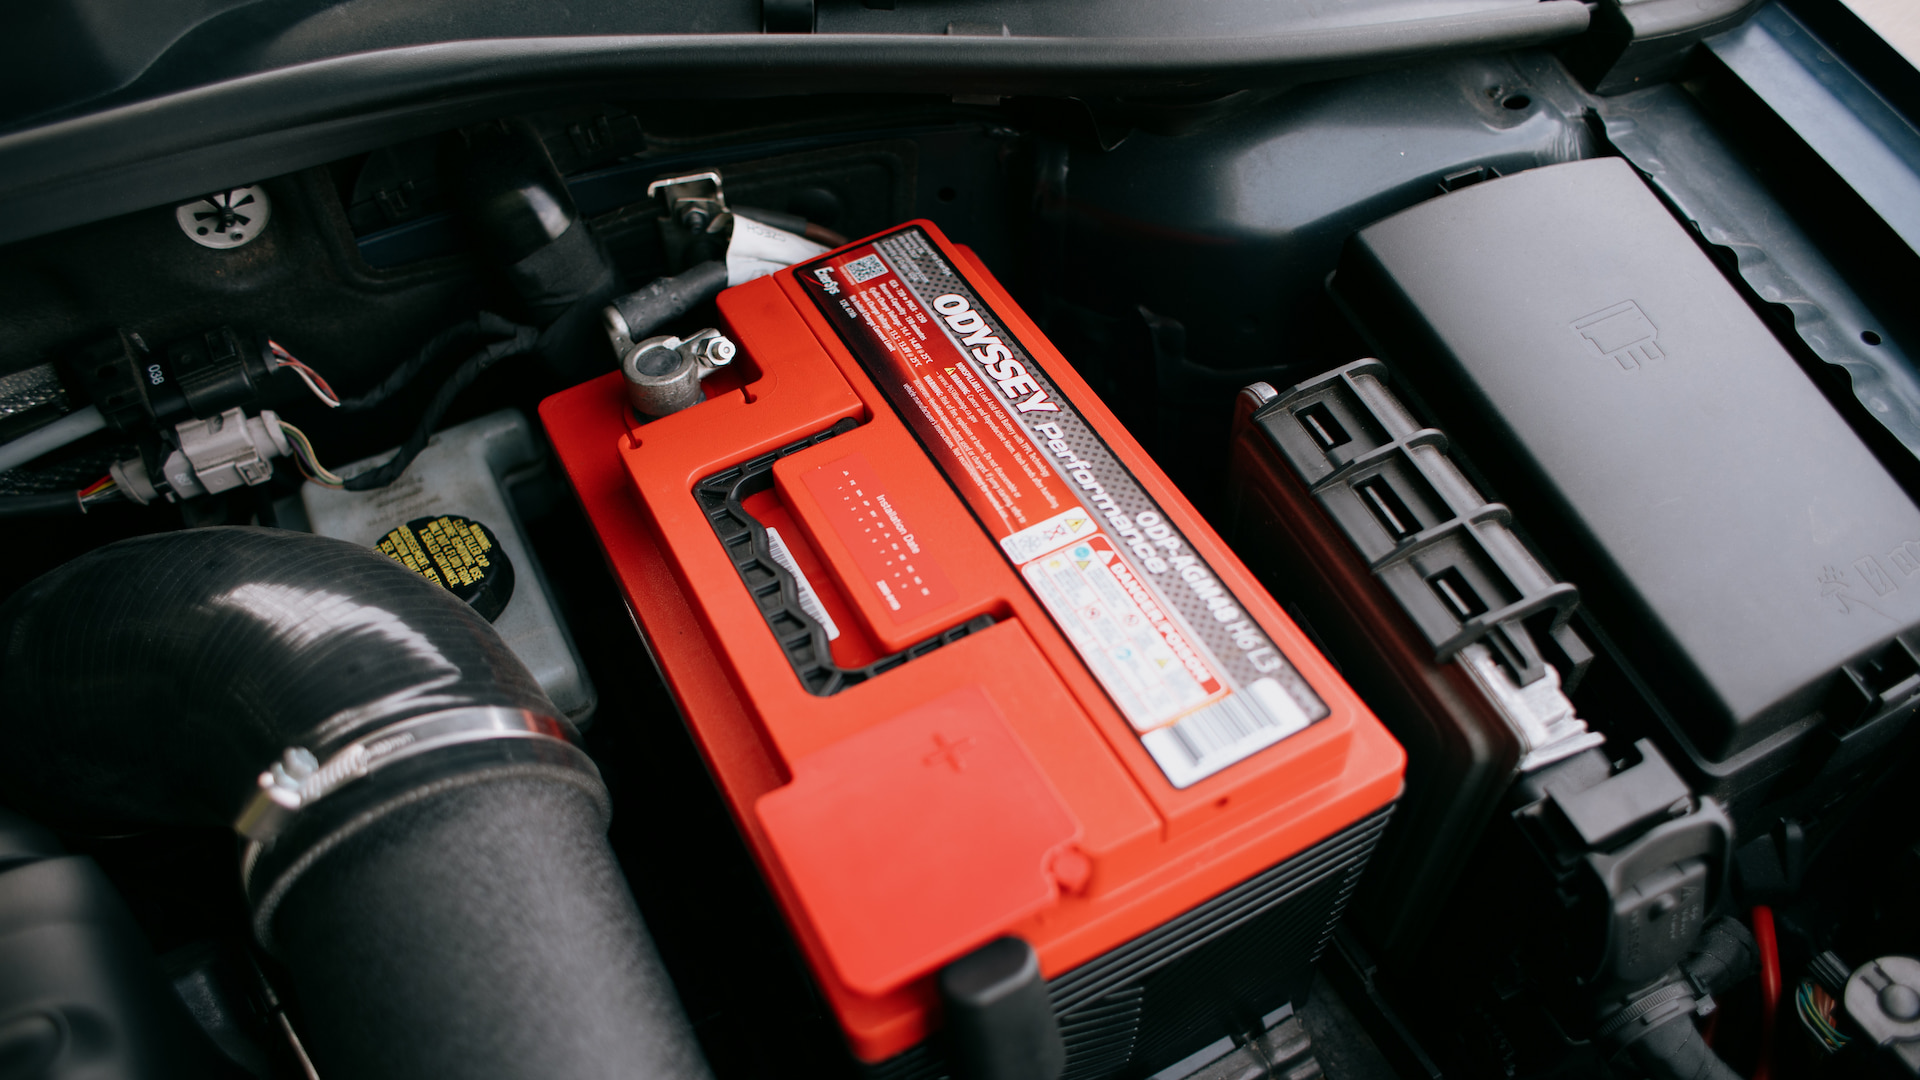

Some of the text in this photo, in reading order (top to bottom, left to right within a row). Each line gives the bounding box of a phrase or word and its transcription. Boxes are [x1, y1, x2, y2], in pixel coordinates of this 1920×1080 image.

[814, 266, 840, 294] EnerSys
[866, 300, 880, 316] Charge
[876, 297, 891, 312] Charge
[862, 311, 876, 327] Charge
[872, 325, 888, 341] Current
[883, 339, 896, 352] Limit
[910, 323, 927, 341] minutes
[933, 293, 1060, 415] ODYSSEY
[148, 364, 165, 385] 038
[903, 383, 917, 397] vehicle
[952, 447, 962, 457] Not
[923, 374, 943, 397] WARNING:
[939, 395, 950, 405] Risk
[955, 417, 973, 436] explosion
[983, 452, 992, 460] Do
[988, 459, 998, 468] not
[994, 466, 1017, 493] disassemble
[950, 373, 970, 395] WARNING:
[966, 394, 980, 408] Cancer
[976, 407, 988, 416] and
[983, 414, 1006, 441] Reproductive
[1013, 452, 1026, 465] Wash
[1022, 463, 1036, 478] hands
[1031, 477, 1044, 488] after
[955, 362, 984, 393] NONSPILLABLE
[978, 391, 992, 402] Lead
[986, 401, 999, 411] Acid
[993, 409, 1006, 420] AGM
[1001, 418, 1016, 435] Battery
[1013, 433, 1024, 444] with
[1029, 452, 1050, 477] Technology
[949, 427, 964, 442] where
[958, 440, 973, 452] used
[985, 476, 1000, 489] jump
[1010, 506, 1022, 517] refer
[1035, 421, 1169, 574] Performance
[452, 519, 490, 567] CLEAN FILLER CAP
[876, 494, 920, 554] Installation Date
[421, 532, 441, 554] SEALED
[433, 552, 460, 588] CONTAINER.
[445, 549, 463, 568] FLUID
[455, 566, 474, 586] FROM
[469, 566, 484, 581] USE
[1137, 512, 1237, 621] ODP-AGM48
[1225, 620, 1262, 649] H6
[1246, 647, 1281, 672] L3
